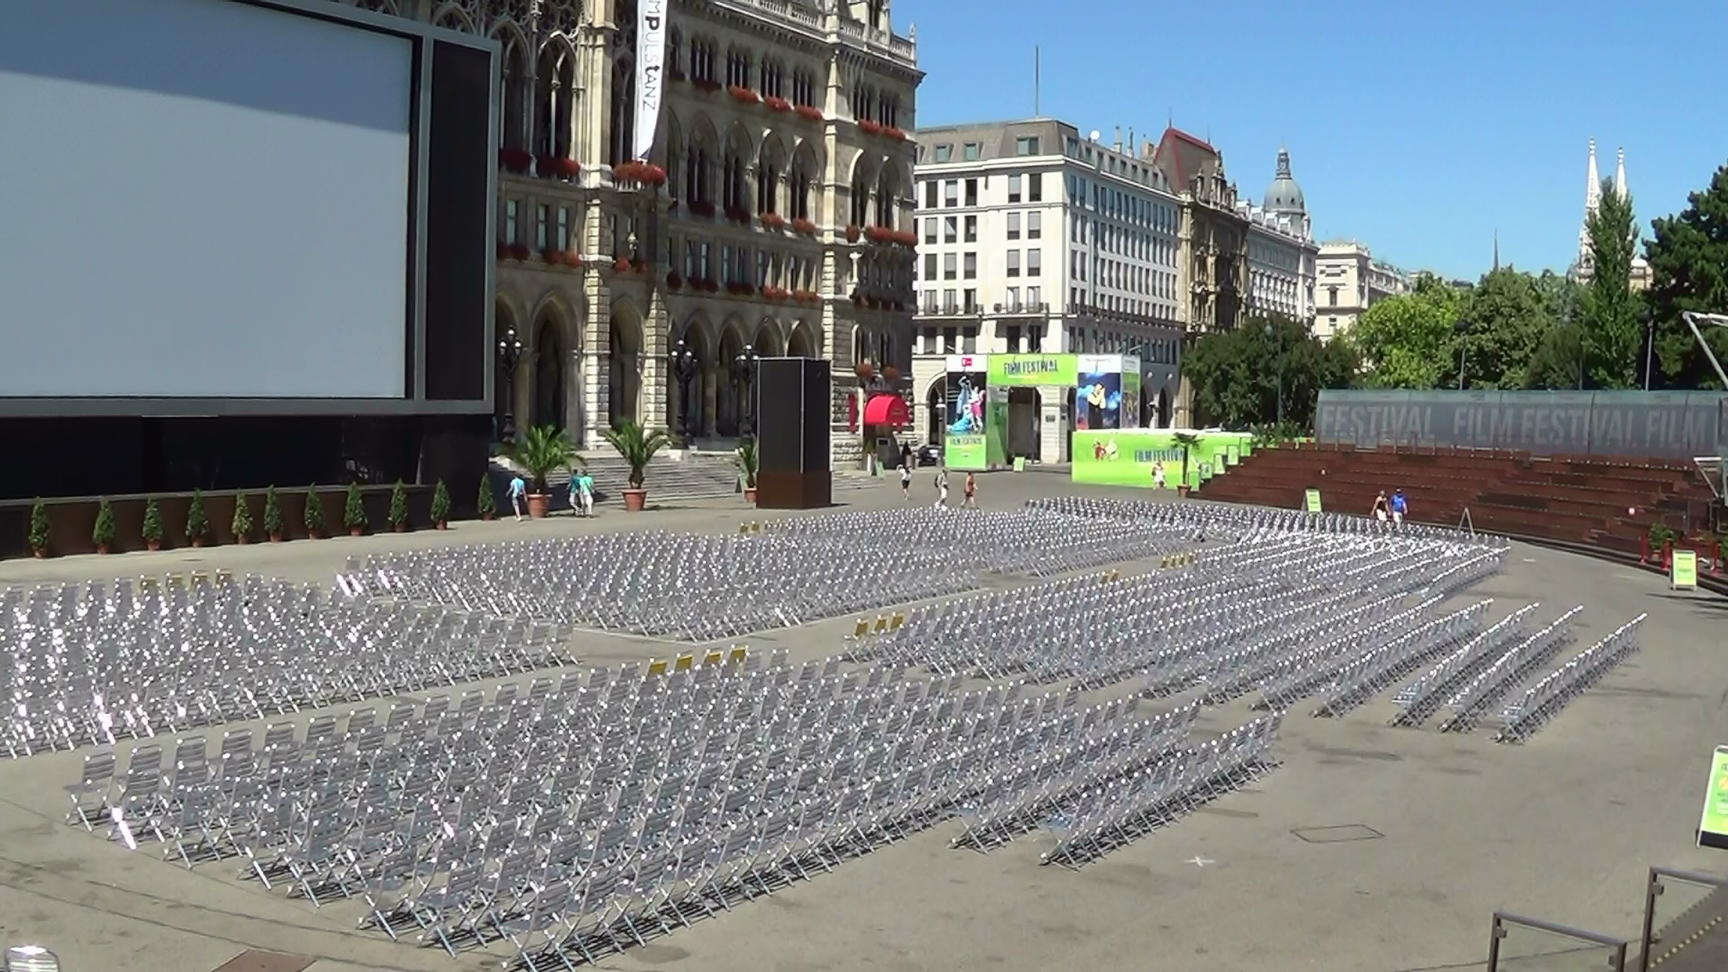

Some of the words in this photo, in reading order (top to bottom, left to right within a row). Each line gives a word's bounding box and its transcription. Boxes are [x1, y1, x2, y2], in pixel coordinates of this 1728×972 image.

[1022, 359, 1059, 373] FESTIVAL
[1321, 405, 1436, 442] FESTIVAL
[1453, 407, 1513, 444] FILM
[1520, 408, 1636, 449] FESTIVAL
[1645, 409, 1707, 450] FILM
[1134, 449, 1152, 463] FILM
[1153, 447, 1184, 462] FESTIVA
